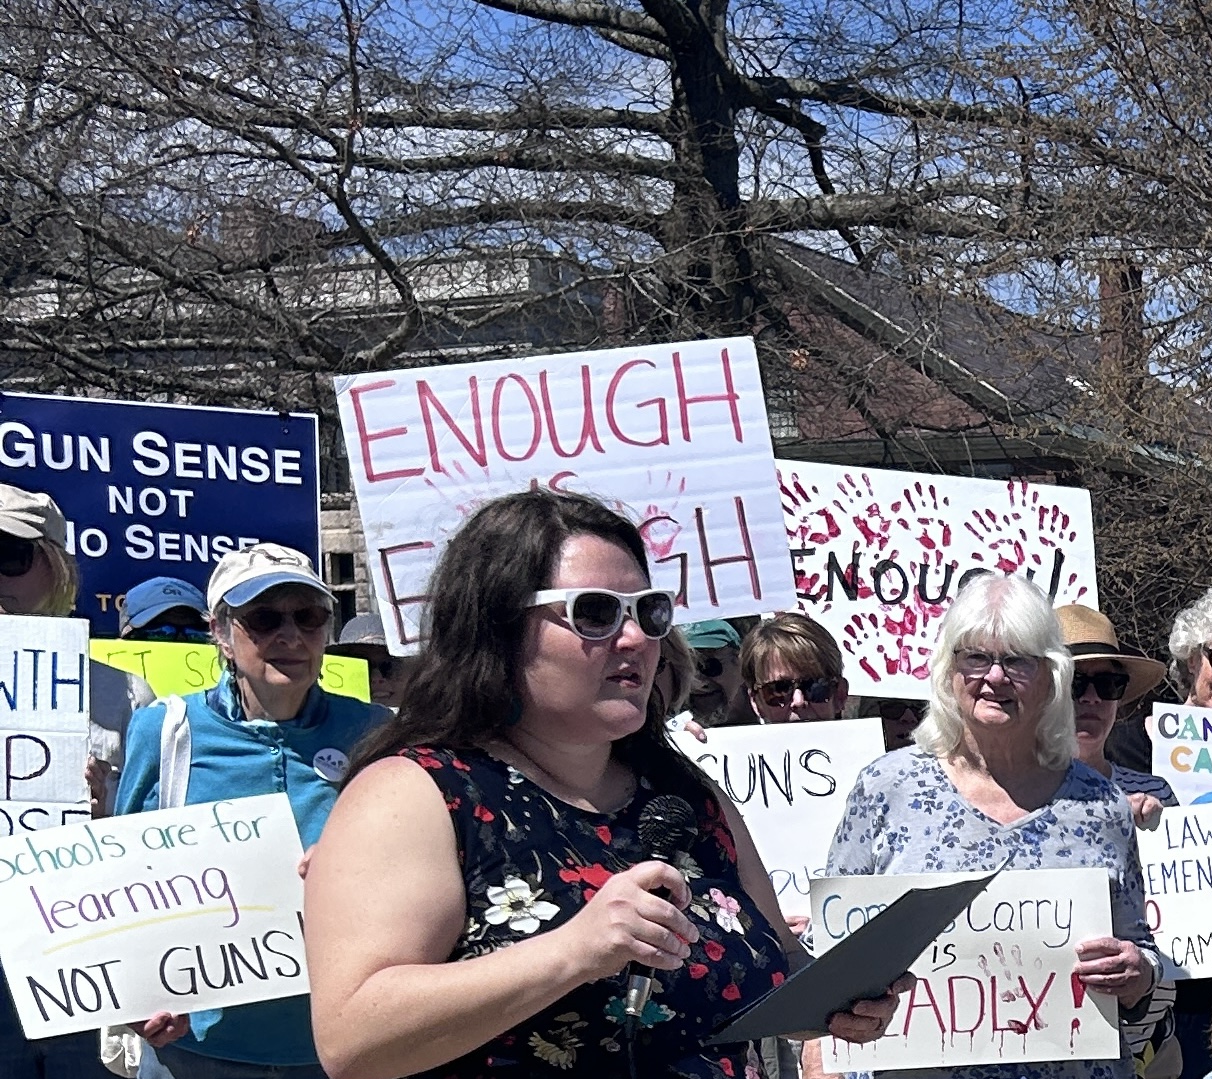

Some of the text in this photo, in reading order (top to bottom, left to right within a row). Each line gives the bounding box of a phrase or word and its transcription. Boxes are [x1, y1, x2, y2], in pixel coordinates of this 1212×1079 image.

[349, 347, 743, 483] ENOUGH
[0, 421, 303, 485] GUN SENSE
[107, 485, 195, 518] NOT
[378, 496, 763, 645] EGH
[141, 820, 199, 851] are
[210, 801, 270, 843] for
[29, 864, 241, 935] learning
[966, 896, 1074, 949] Carry
[931, 937, 958, 973] is
[26, 959, 122, 1022] NOT
